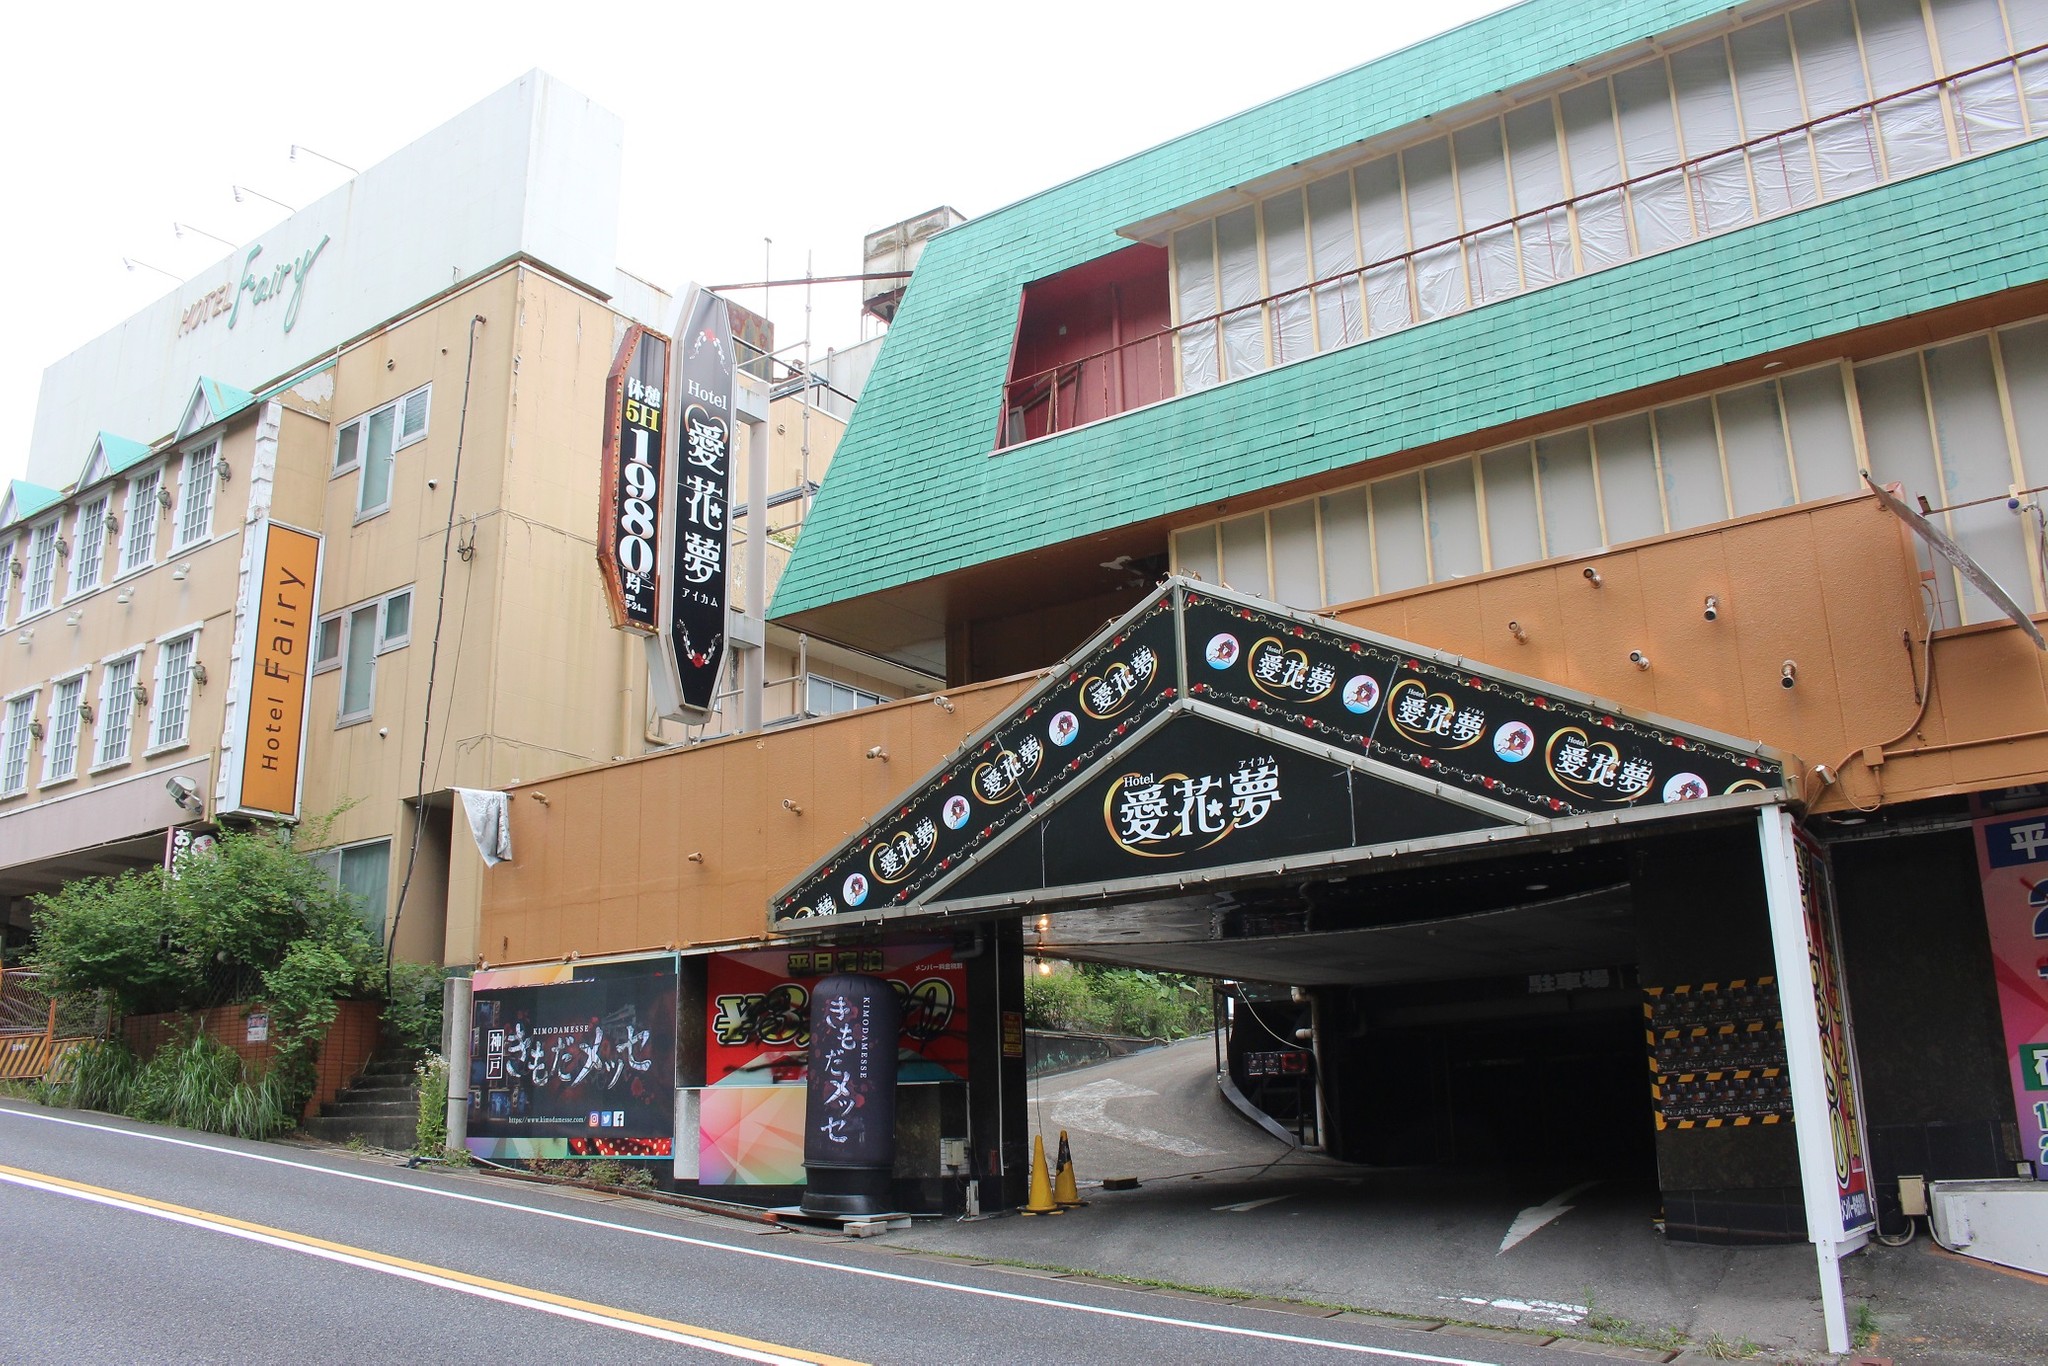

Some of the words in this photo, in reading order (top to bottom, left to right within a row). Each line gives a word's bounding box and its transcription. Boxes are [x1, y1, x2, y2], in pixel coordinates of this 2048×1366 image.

[179, 282, 232, 338] HOTEL
[228, 235, 330, 333] Fairy
[626, 398, 659, 432] 5H
[628, 377, 661, 408] 休憩
[687, 379, 727, 410] Hotel
[619, 428, 657, 574] 1980
[683, 418, 725, 583] 愛花夢
[682, 587, 719, 607] アイカム
[264, 566, 306, 684] Fairy
[1091, 647, 1155, 714] 愛花夢
[1256, 652, 1336, 694] 愛花夢
[262, 697, 284, 771] Hotel
[1396, 695, 1485, 741] 愛花夢
[1567, 736, 1586, 746] Hotel
[982, 736, 1041, 799] 愛花夢
[1123, 773, 1154, 788] Hotel
[1238, 755, 1275, 769] アイカム
[1554, 743, 1653, 793] 愛花夢
[1120, 765, 1282, 845] 愛花夢
[880, 819, 936, 879] 愛花夢
[488, 1032, 502, 1076] 神戸
[533, 1025, 589, 1035] KIMODAMESSE
[859, 997, 870, 1079] KIMODAMESSE
[506, 1023, 652, 1090] きもだメッセ
[820, 996, 857, 1143] きもだメッセ
[508, 1115, 587, 1125] https://www.kimodamesse.com/
